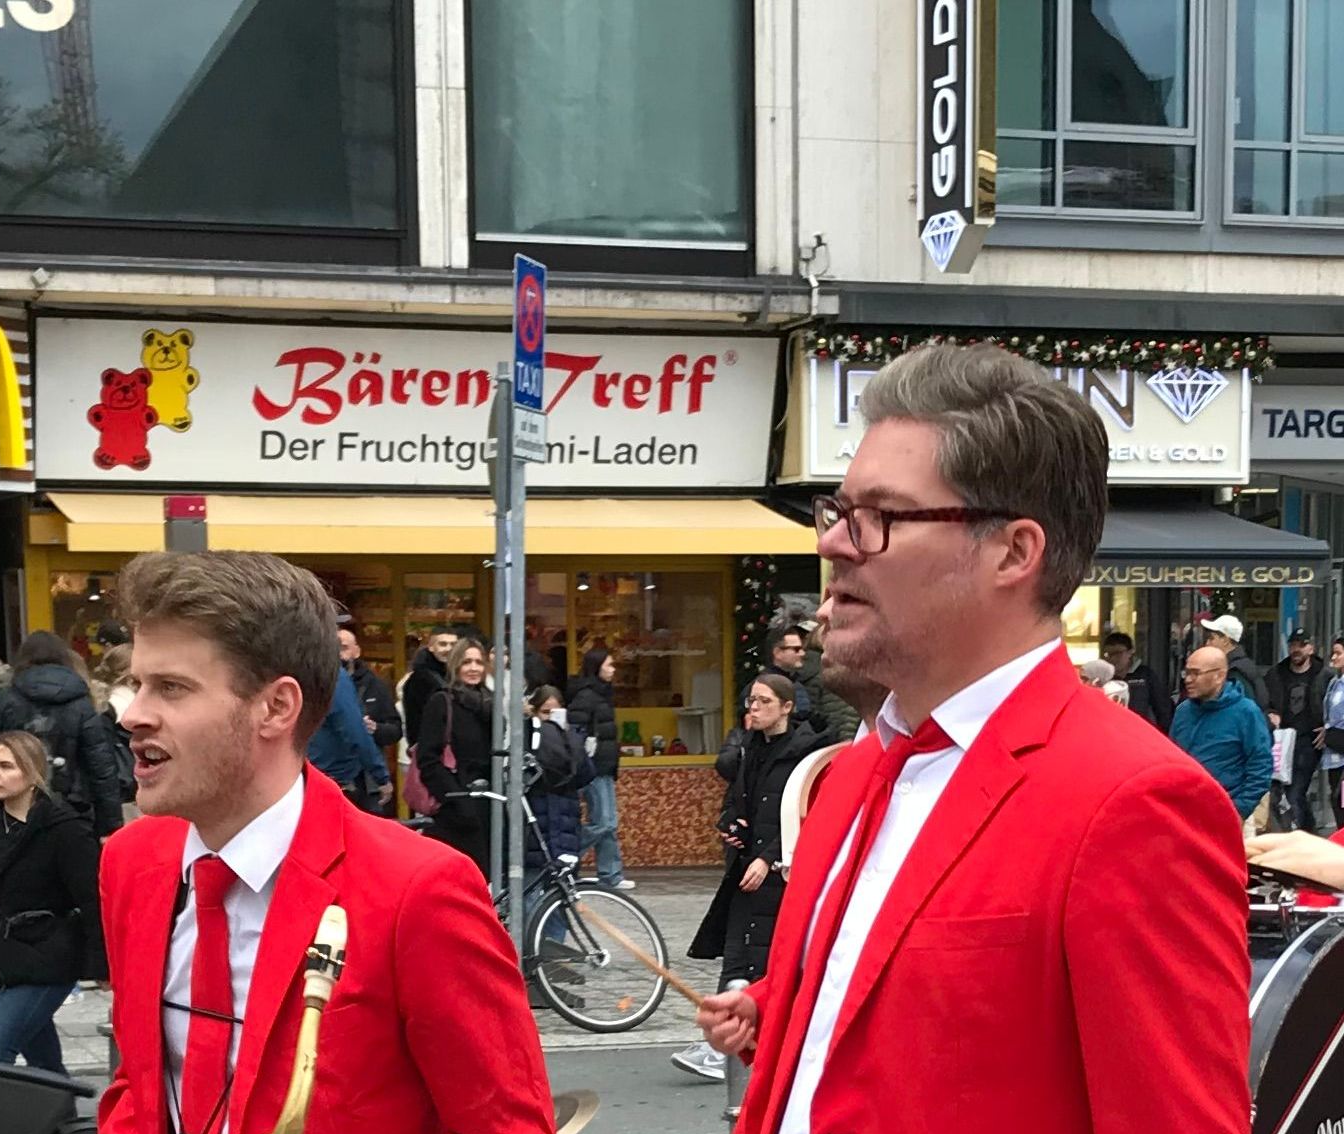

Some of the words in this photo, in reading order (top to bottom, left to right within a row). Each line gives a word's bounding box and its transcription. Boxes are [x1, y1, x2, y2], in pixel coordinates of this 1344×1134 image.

[932, 0, 957, 197] GOLD
[516, 361, 541, 398] TAXI
[259, 430, 324, 461] Der
[338, 432, 698, 470] Fruchtgmi-Laden
[1168, 443, 1229, 462] GOLD
[1083, 565, 1226, 583] UXUSUHREN
[1231, 566, 1247, 583] &
[1251, 566, 1315, 583] GOLD
